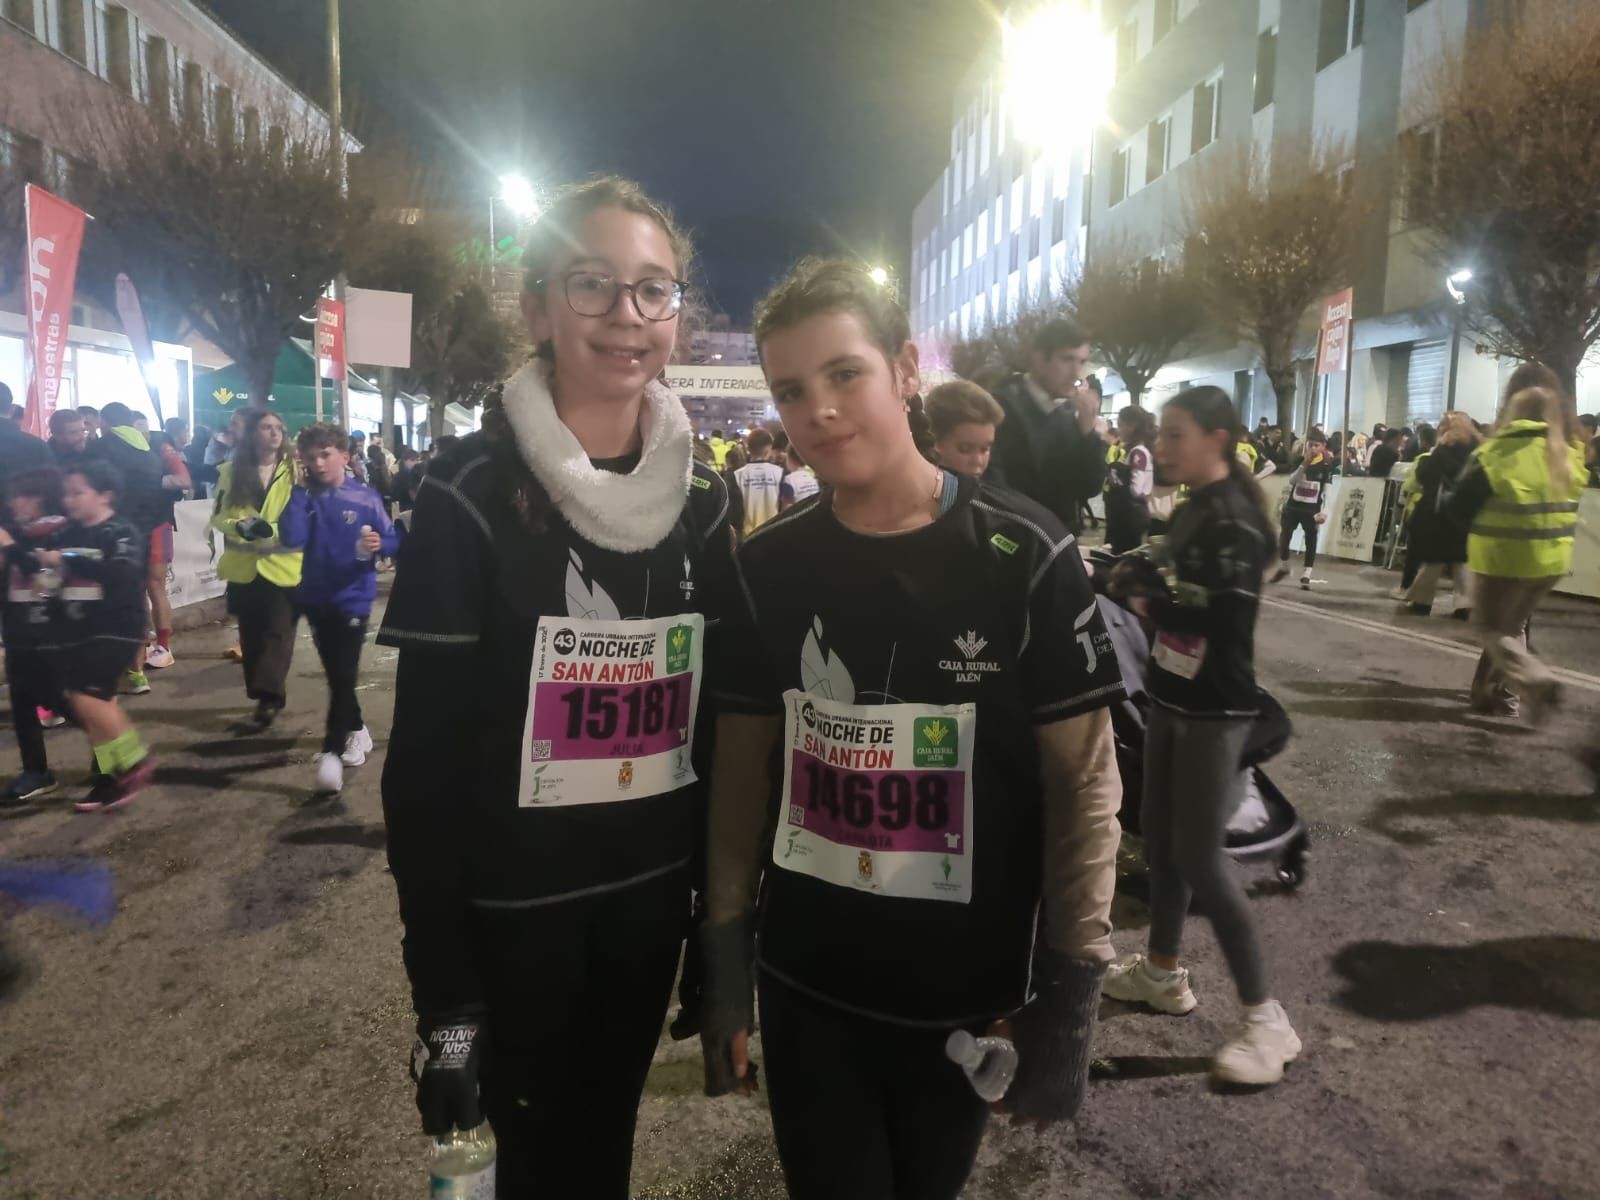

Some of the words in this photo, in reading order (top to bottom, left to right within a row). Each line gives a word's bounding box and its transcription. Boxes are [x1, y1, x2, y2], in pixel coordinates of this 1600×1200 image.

[554, 634, 575, 649] 43
[578, 639, 641, 659] NOCHE
[640, 638, 657, 657] DE
[551, 661, 595, 682] SAN
[597, 657, 655, 683] ANTÓN
[965, 661, 1001, 672] RURAL
[560, 679, 681, 740] 15187
[803, 706, 816, 723] 43
[816, 717, 866, 745] NOCHE
[869, 727, 895, 744] DE
[852, 717, 894, 726] INTERNACIONAL
[803, 733, 826, 761] SAN
[828, 744, 895, 769] ANTÓN
[804, 761, 950, 832] 14698
[441, 1041, 473, 1054] SAN
